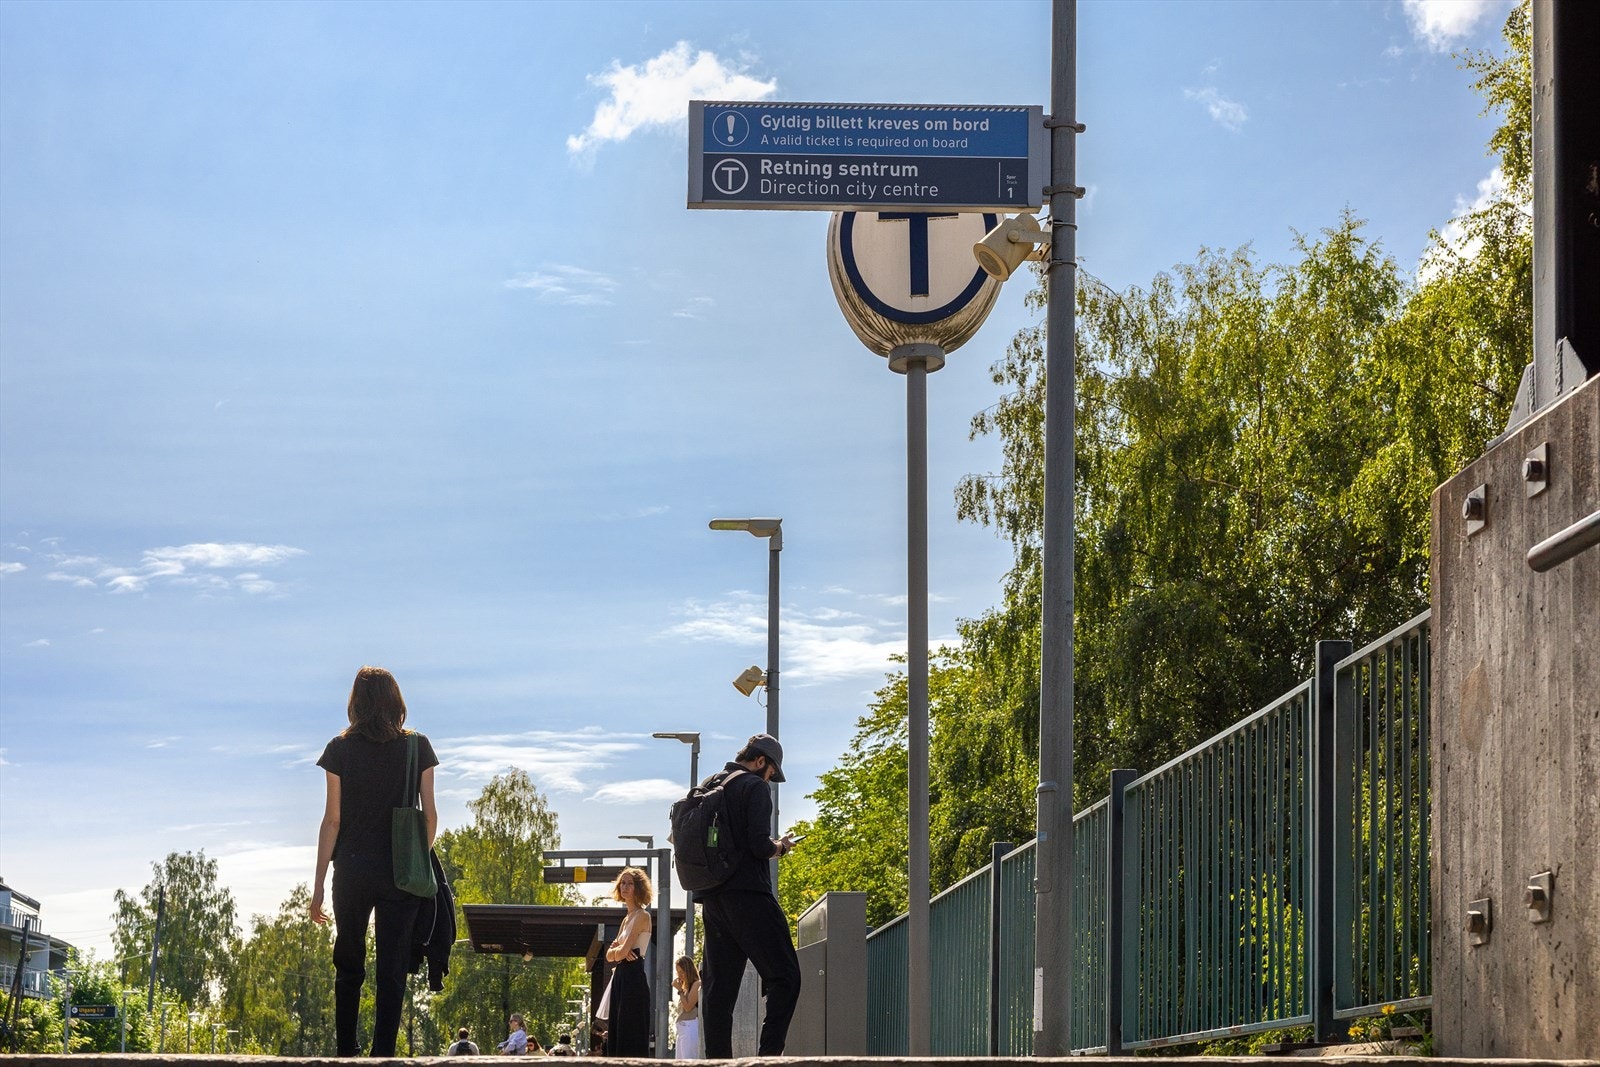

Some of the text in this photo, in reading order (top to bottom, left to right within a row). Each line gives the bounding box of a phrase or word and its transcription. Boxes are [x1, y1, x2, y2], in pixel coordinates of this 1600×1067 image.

[760, 114, 990, 131] Gyldig billett kreves om bord
[760, 134, 968, 149] A valid ticket is required on board
[760, 159, 918, 179] Retning sentrum
[721, 167, 739, 190] T
[760, 179, 939, 199] Direction city centre
[1007, 187, 1013, 198] 1
